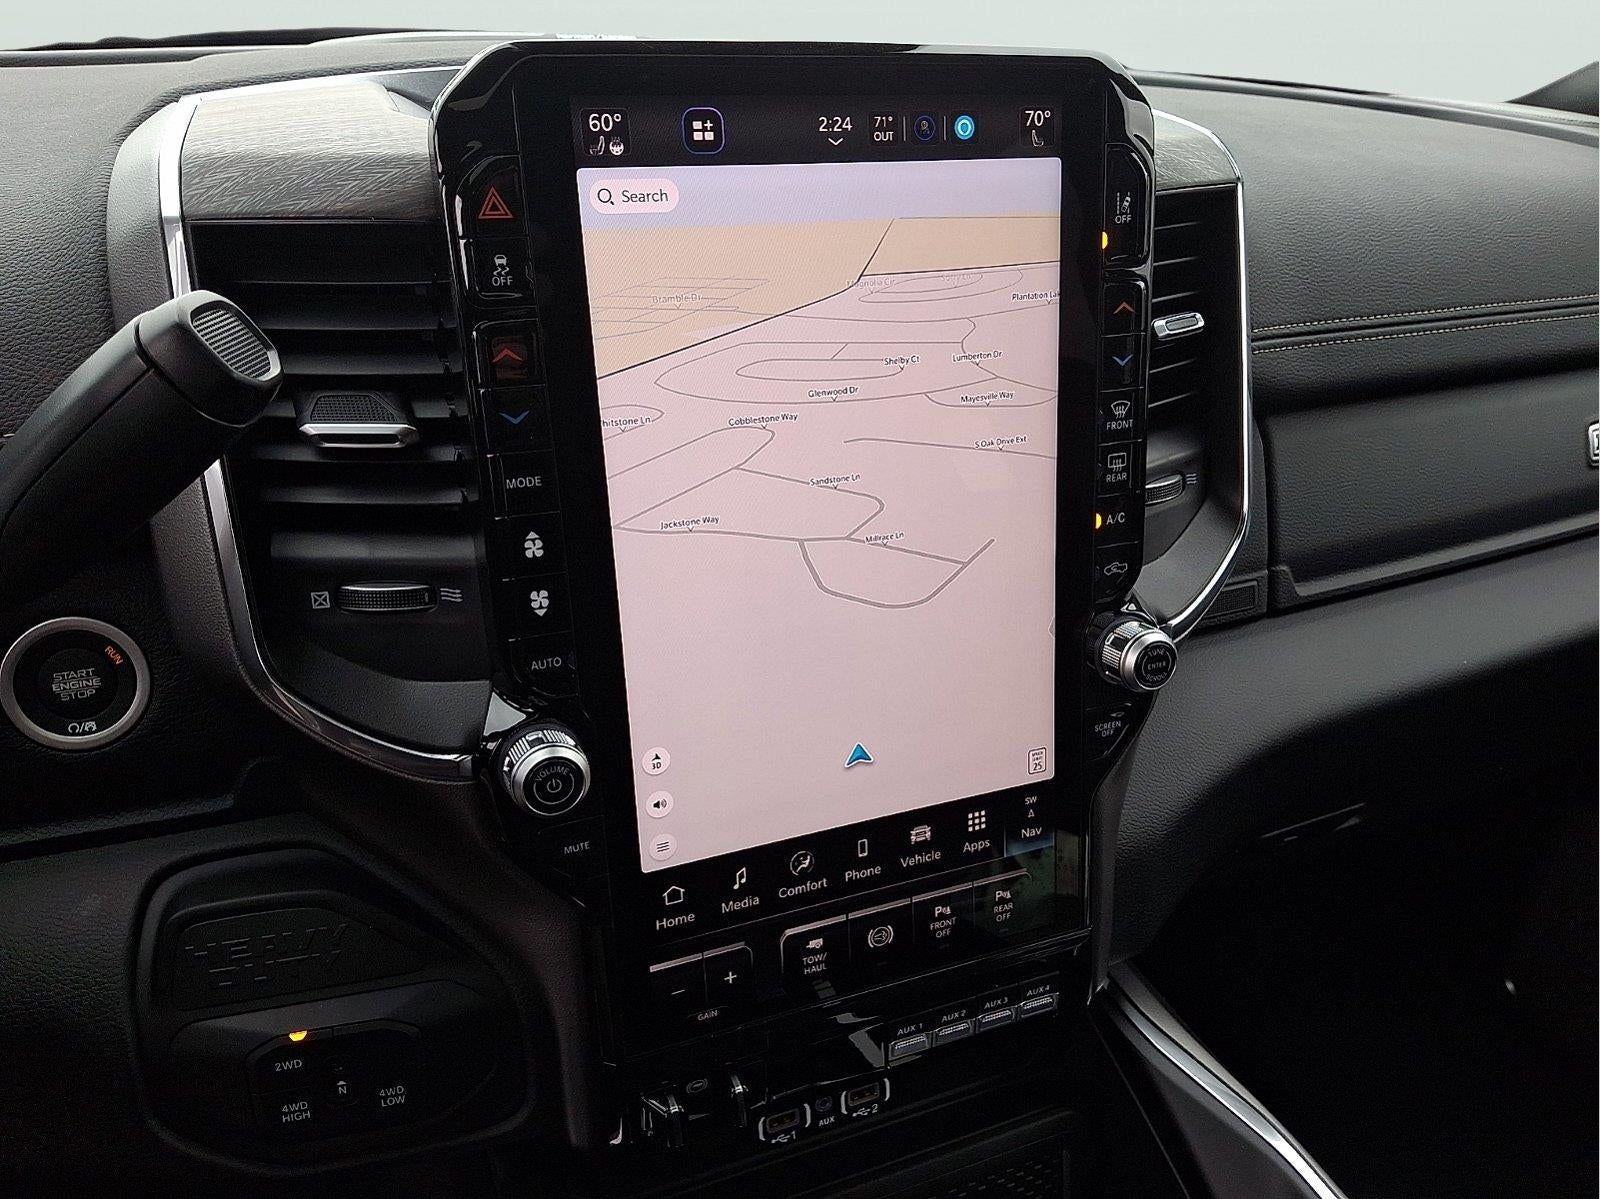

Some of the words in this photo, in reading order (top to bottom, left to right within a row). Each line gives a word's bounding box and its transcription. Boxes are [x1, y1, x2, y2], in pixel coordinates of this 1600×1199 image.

[589, 114, 622, 132] 60°
[818, 116, 853, 132] 2:24
[1025, 110, 1052, 126] 70°
[873, 130, 894, 142] OUT
[622, 188, 669, 204] Search
[1114, 215, 1132, 224] OFF
[491, 275, 513, 287] OFF
[652, 293, 689, 304] Bramble
[1012, 291, 1048, 301] Plantation
[884, 356, 910, 368] Shelby
[911, 355, 921, 364] Ct
[953, 352, 992, 362] Lumberton
[993, 350, 1003, 359] Dr
[808, 387, 848, 398] Glenwood
[849, 386, 859, 394] Dr
[960, 392, 998, 403] Mayesville
[999, 391, 1014, 401] Way
[601, 417, 639, 428] hitstone
[641, 416, 651, 424] Ln
[728, 415, 780, 427] Cobblestone
[781, 413, 798, 423] Way
[1106, 418, 1134, 431] FRONT
[980, 439, 996, 448] Oak
[996, 437, 1015, 447] Drive
[1015, 436, 1027, 445] Ext
[506, 475, 542, 489] MODE
[809, 475, 850, 486] Sandstone
[851, 473, 861, 482] Ln
[1105, 472, 1127, 483] REAR
[660, 518, 701, 530] Jackstone
[702, 516, 720, 526] Way
[1106, 512, 1126, 525] A/C
[895, 531, 905, 540] Ln
[104, 645, 124, 665] RUN
[531, 656, 562, 671] AUTO
[53, 668, 95, 681] START
[52, 677, 101, 692] ENGINE
[60, 689, 96, 701] STOP
[1094, 720, 1121, 732] SCREEN
[1101, 729, 1115, 738] OFF
[651, 761, 662, 770] 3D
[1033, 761, 1043, 771] 25
[535, 765, 570, 782] VOLUME
[1024, 796, 1037, 805] SW
[1021, 826, 1043, 839] Nav
[564, 841, 591, 855] MUTE
[963, 839, 991, 853] Apps
[900, 849, 942, 868] Vehicle
[845, 865, 882, 882] Phone
[778, 878, 828, 899] Comfort
[721, 895, 760, 914] Media
[993, 902, 1014, 914] REAR
[656, 913, 695, 931] Home
[930, 916, 957, 931] FRONT
[996, 911, 1012, 923] OFF
[936, 928, 951, 938] OFF
[802, 951, 828, 966] TOW/
[804, 963, 827, 975] HAUL
[1026, 987, 1044, 997] AUX
[983, 998, 1002, 1010] AUX
[697, 1009, 718, 1021] GAIN
[941, 1011, 960, 1023] AUX
[961, 1009, 967, 1018] 2
[897, 1024, 917, 1036] AUX
[274, 1058, 303, 1073] 2WD
[338, 1085, 347, 1095] N
[379, 1085, 405, 1098] 4WD
[281, 1101, 308, 1113] 4WD
[381, 1095, 406, 1108] LOW
[281, 1110, 311, 1123] HIGH
[818, 1115, 835, 1126] AUX
